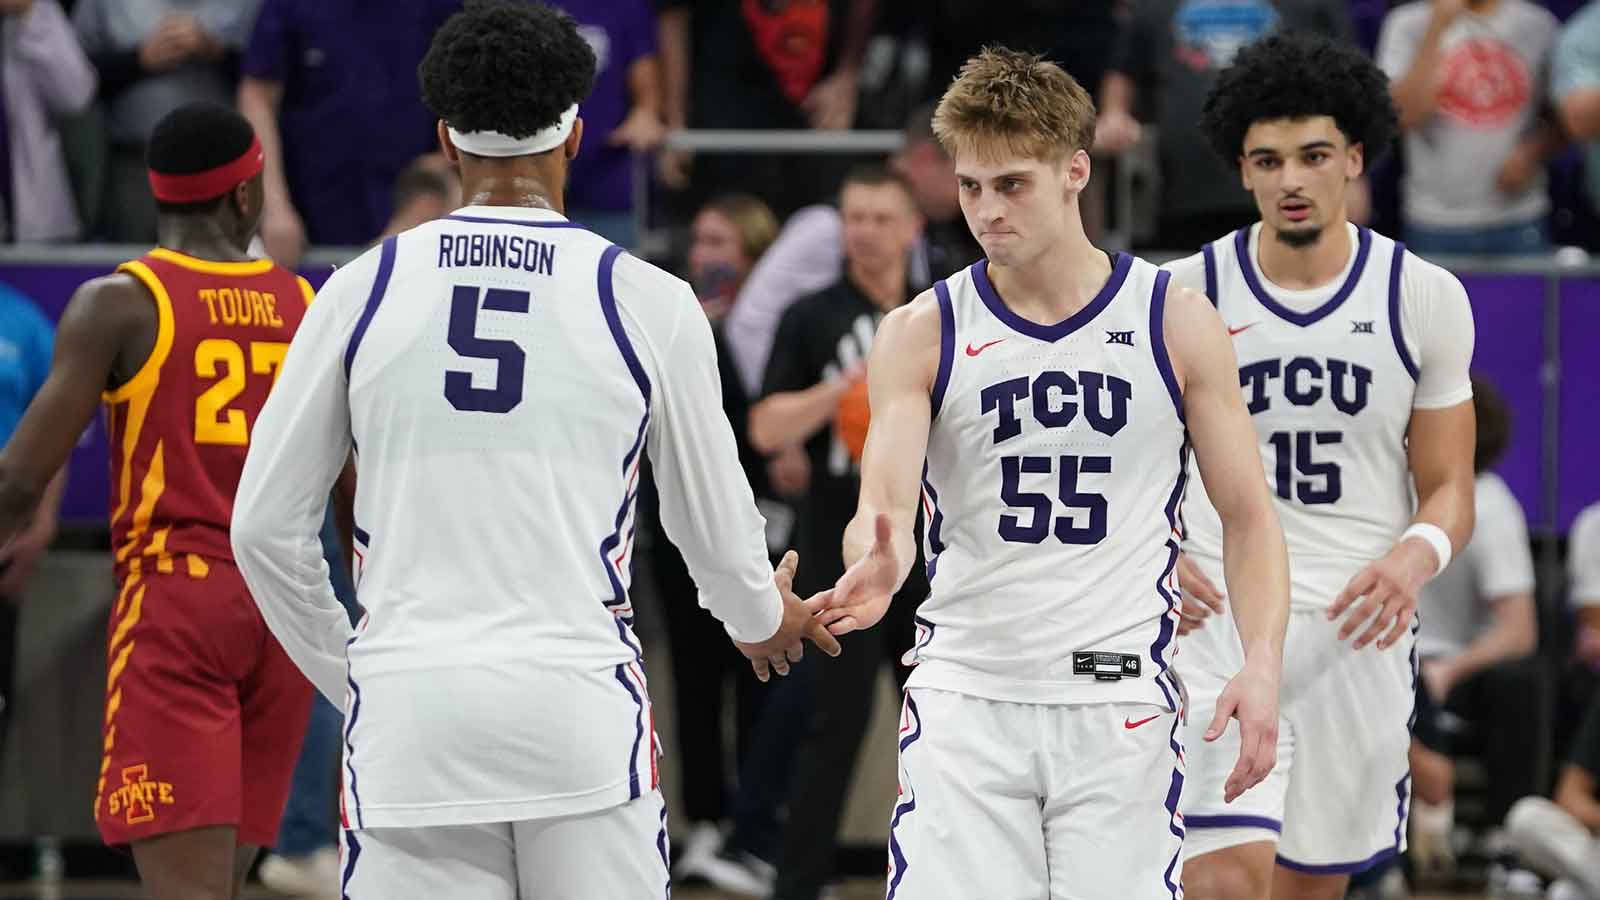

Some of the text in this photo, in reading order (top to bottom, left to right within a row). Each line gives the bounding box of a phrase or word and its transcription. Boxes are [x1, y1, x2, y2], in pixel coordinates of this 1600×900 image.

[438, 234, 556, 276] ROBINSON
[199, 287, 283, 327] TOURE
[444, 284, 531, 414] 5
[981, 370, 1133, 445] TCU
[1238, 356, 1373, 416] TCU
[1268, 431, 1344, 505] 15
[997, 455, 1113, 545] 55
[1125, 660, 1137, 669] 46
[109, 781, 174, 814] STATE
